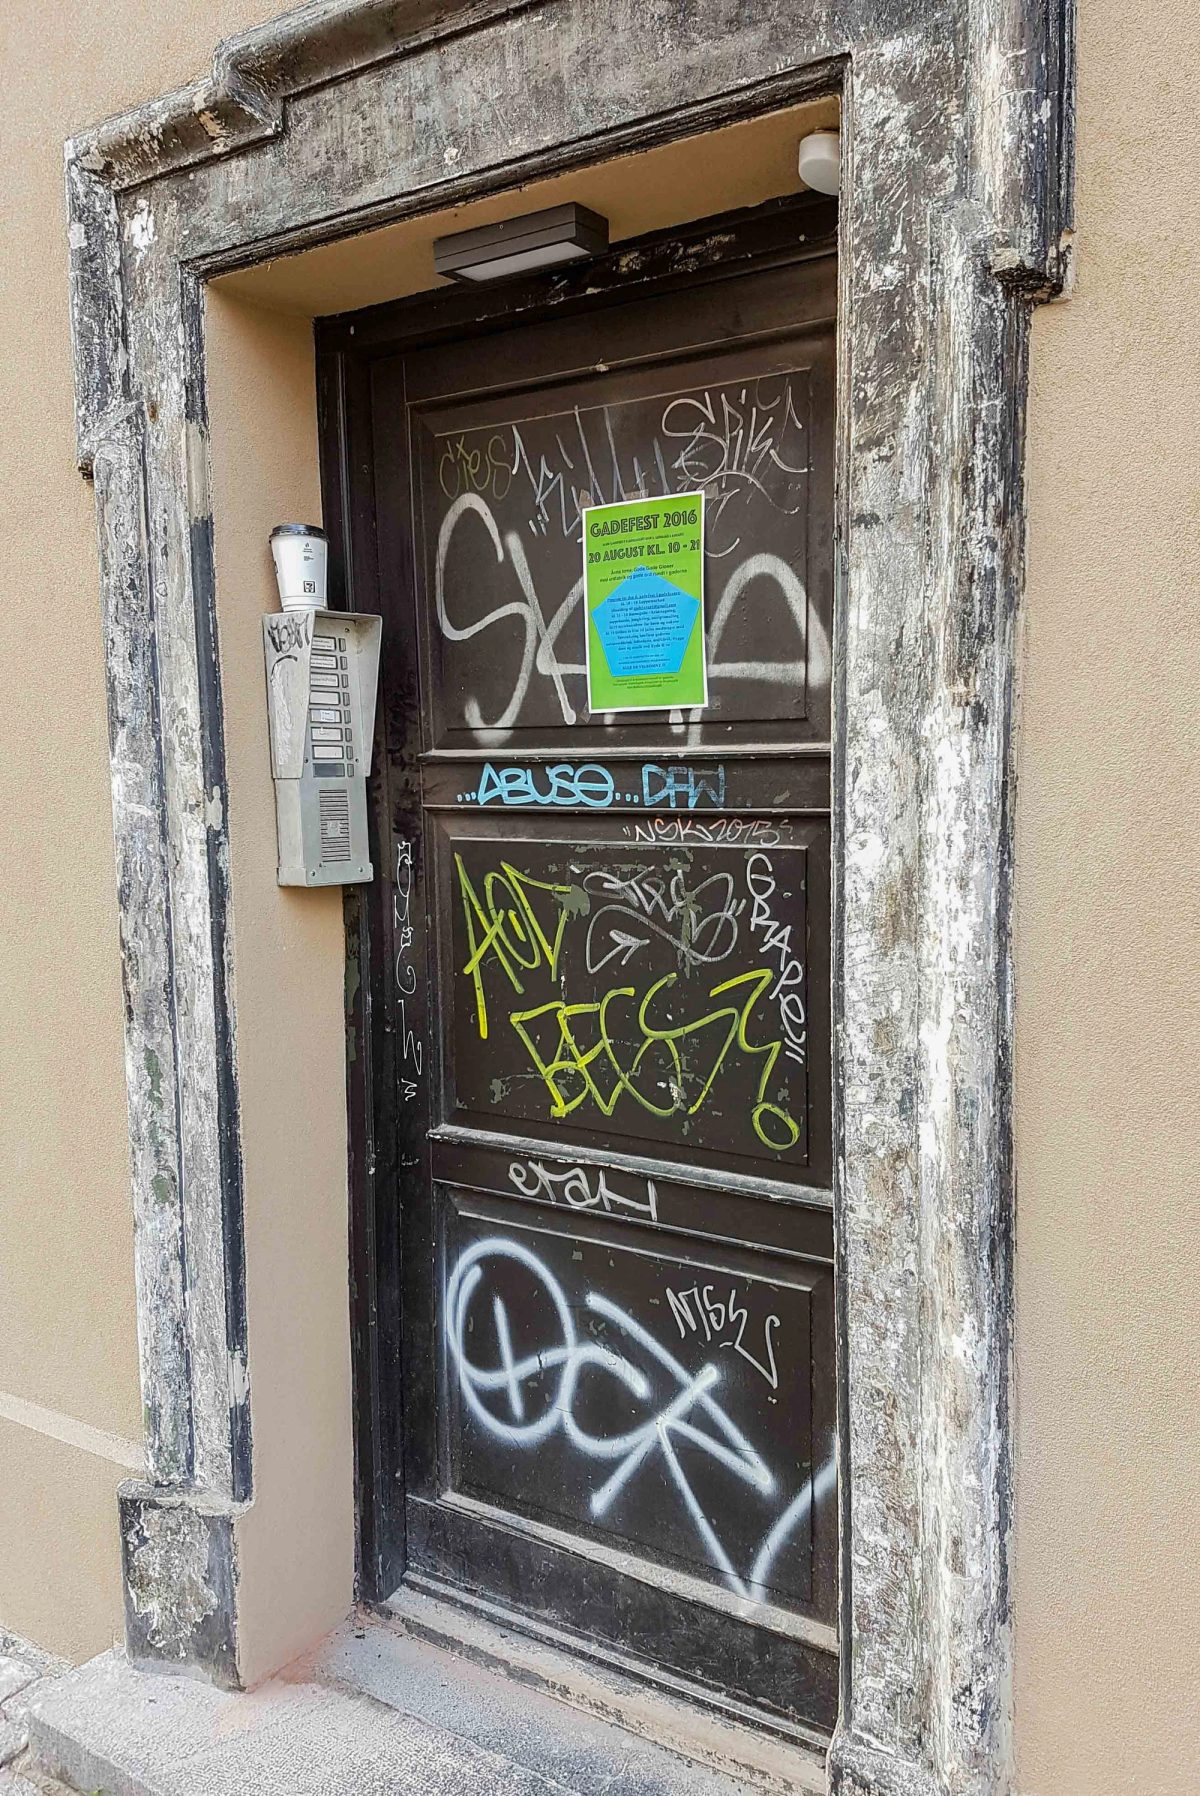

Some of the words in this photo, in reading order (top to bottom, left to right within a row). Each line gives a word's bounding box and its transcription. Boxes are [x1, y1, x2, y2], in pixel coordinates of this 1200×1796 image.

[590, 513, 660, 538] GADEFEST
[663, 509, 698, 528] 2016
[588, 552, 601, 564] 20
[602, 545, 645, 562] AUGUST
[646, 543, 666, 556] KL.
[668, 541, 681, 554] 10
[689, 539, 701, 551] 21
